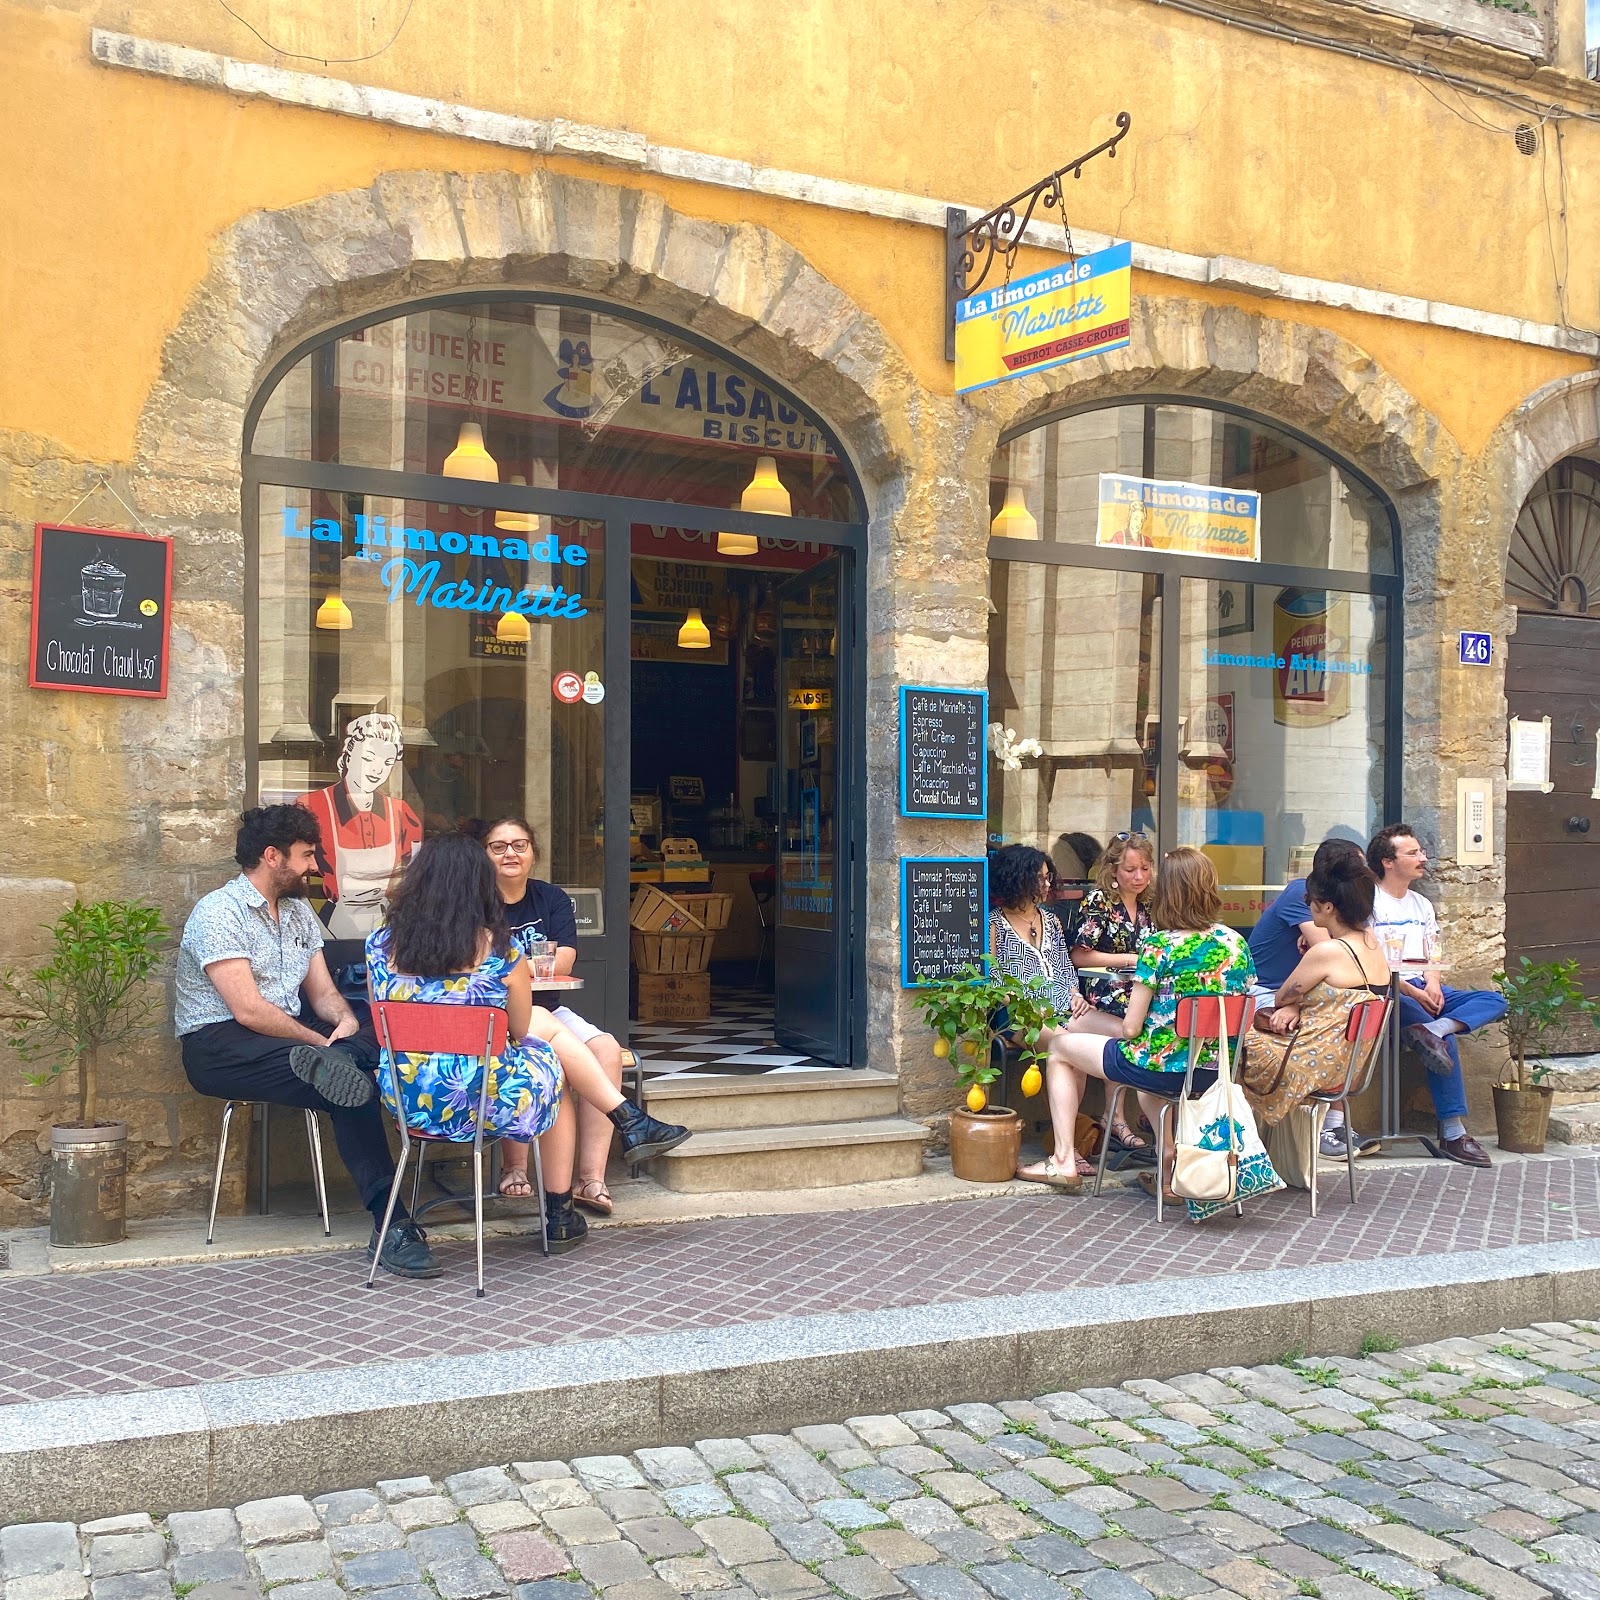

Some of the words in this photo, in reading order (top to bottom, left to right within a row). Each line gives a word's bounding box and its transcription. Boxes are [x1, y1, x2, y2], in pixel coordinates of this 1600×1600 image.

[963, 300, 988, 318] La
[990, 262, 1092, 308] limonade
[991, 312, 1003, 321] de
[1002, 293, 1107, 343] Marinette
[1012, 346, 1052, 366] BISTROT
[1055, 323, 1128, 354] CASSE-CROÛTE
[352, 359, 504, 404] CONFISERIE
[1113, 481, 1140, 501] La
[1143, 485, 1250, 514] limonade
[1154, 508, 1166, 518] de
[1164, 511, 1250, 545] Marinette
[281, 506, 343, 543] La
[354, 513, 588, 567] limonade
[355, 548, 382, 563] de
[380, 556, 588, 620] Marinette
[484, 643, 527, 657] SOLEIL
[1464, 637, 1488, 660] 46
[46, 639, 96, 674] Chocolat
[103, 646, 134, 678] Chaud
[1202, 648, 1286, 669] Limonade
[1289, 653, 1372, 675] Artisanale
[788, 693, 829, 705] AISE
[912, 696, 928, 712] Café
[929, 698, 937, 712] de
[938, 698, 966, 714] Marinette
[912, 712, 943, 729] Espresso
[1199, 709, 1219, 722] PILE
[912, 727, 929, 742] Petit
[931, 728, 956, 744] Crème
[912, 759, 931, 773] Latte
[934, 760, 967, 775] Macchiato
[913, 788, 940, 805] Chocolat
[941, 790, 961, 805] Chaud
[912, 868, 942, 882] Limonade
[945, 868, 968, 883] Pression
[913, 884, 942, 898] Limonade
[944, 883, 966, 897] Florale
[913, 899, 930, 913] Café
[934, 899, 952, 913] Limé
[913, 914, 939, 928] Diabolo
[913, 930, 937, 944] Double
[938, 929, 961, 943] Citron
[913, 945, 944, 959] Limonade
[946, 944, 970, 963] Réglisse
[912, 960, 941, 978] Orange
[652, 1006, 696, 1017] BORDEAUX
